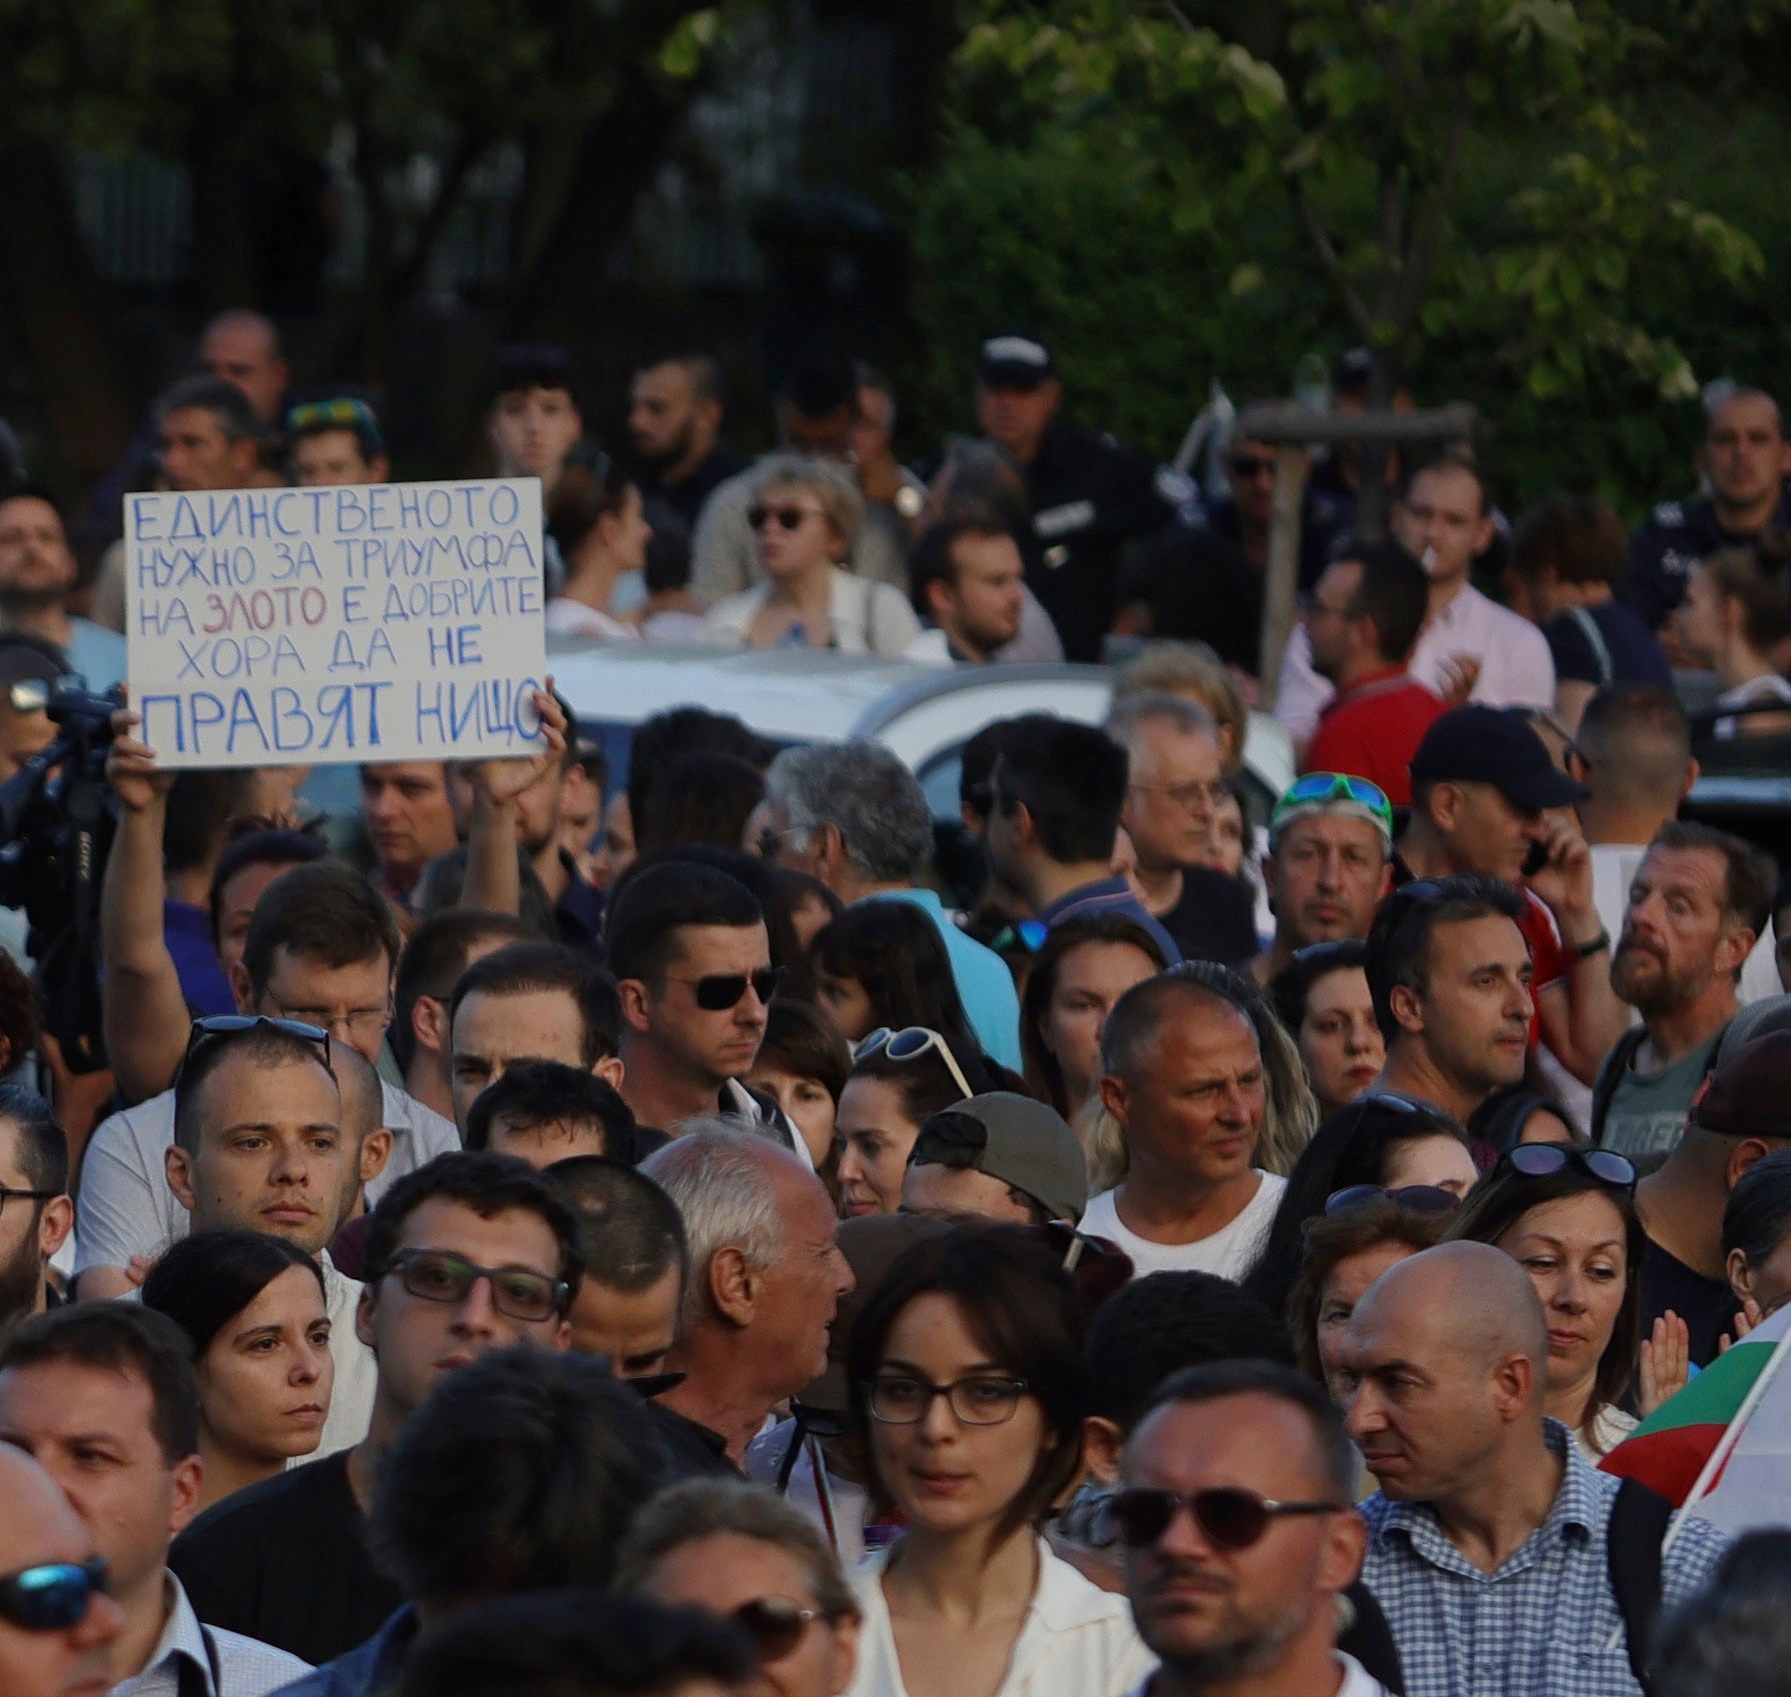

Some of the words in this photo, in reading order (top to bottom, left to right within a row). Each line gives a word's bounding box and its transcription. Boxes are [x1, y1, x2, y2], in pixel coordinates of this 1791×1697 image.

[133, 484, 520, 546] ЕДИНСТВЕНОТО
[137, 545, 257, 588] НУЖНО
[270, 542, 323, 580] ЗА
[333, 530, 536, 577] ТРИУМФА
[140, 596, 196, 636] НА
[202, 585, 328, 634] ЗЛОТО
[342, 586, 370, 623] Е
[383, 576, 542, 623] ДОБРИТЕ
[177, 635, 306, 680] ХОРА
[328, 628, 398, 673] ДА
[428, 624, 484, 667] НЕ
[139, 681, 394, 753] ПРАВЯТ
[417, 677, 546, 745] НИЩО
